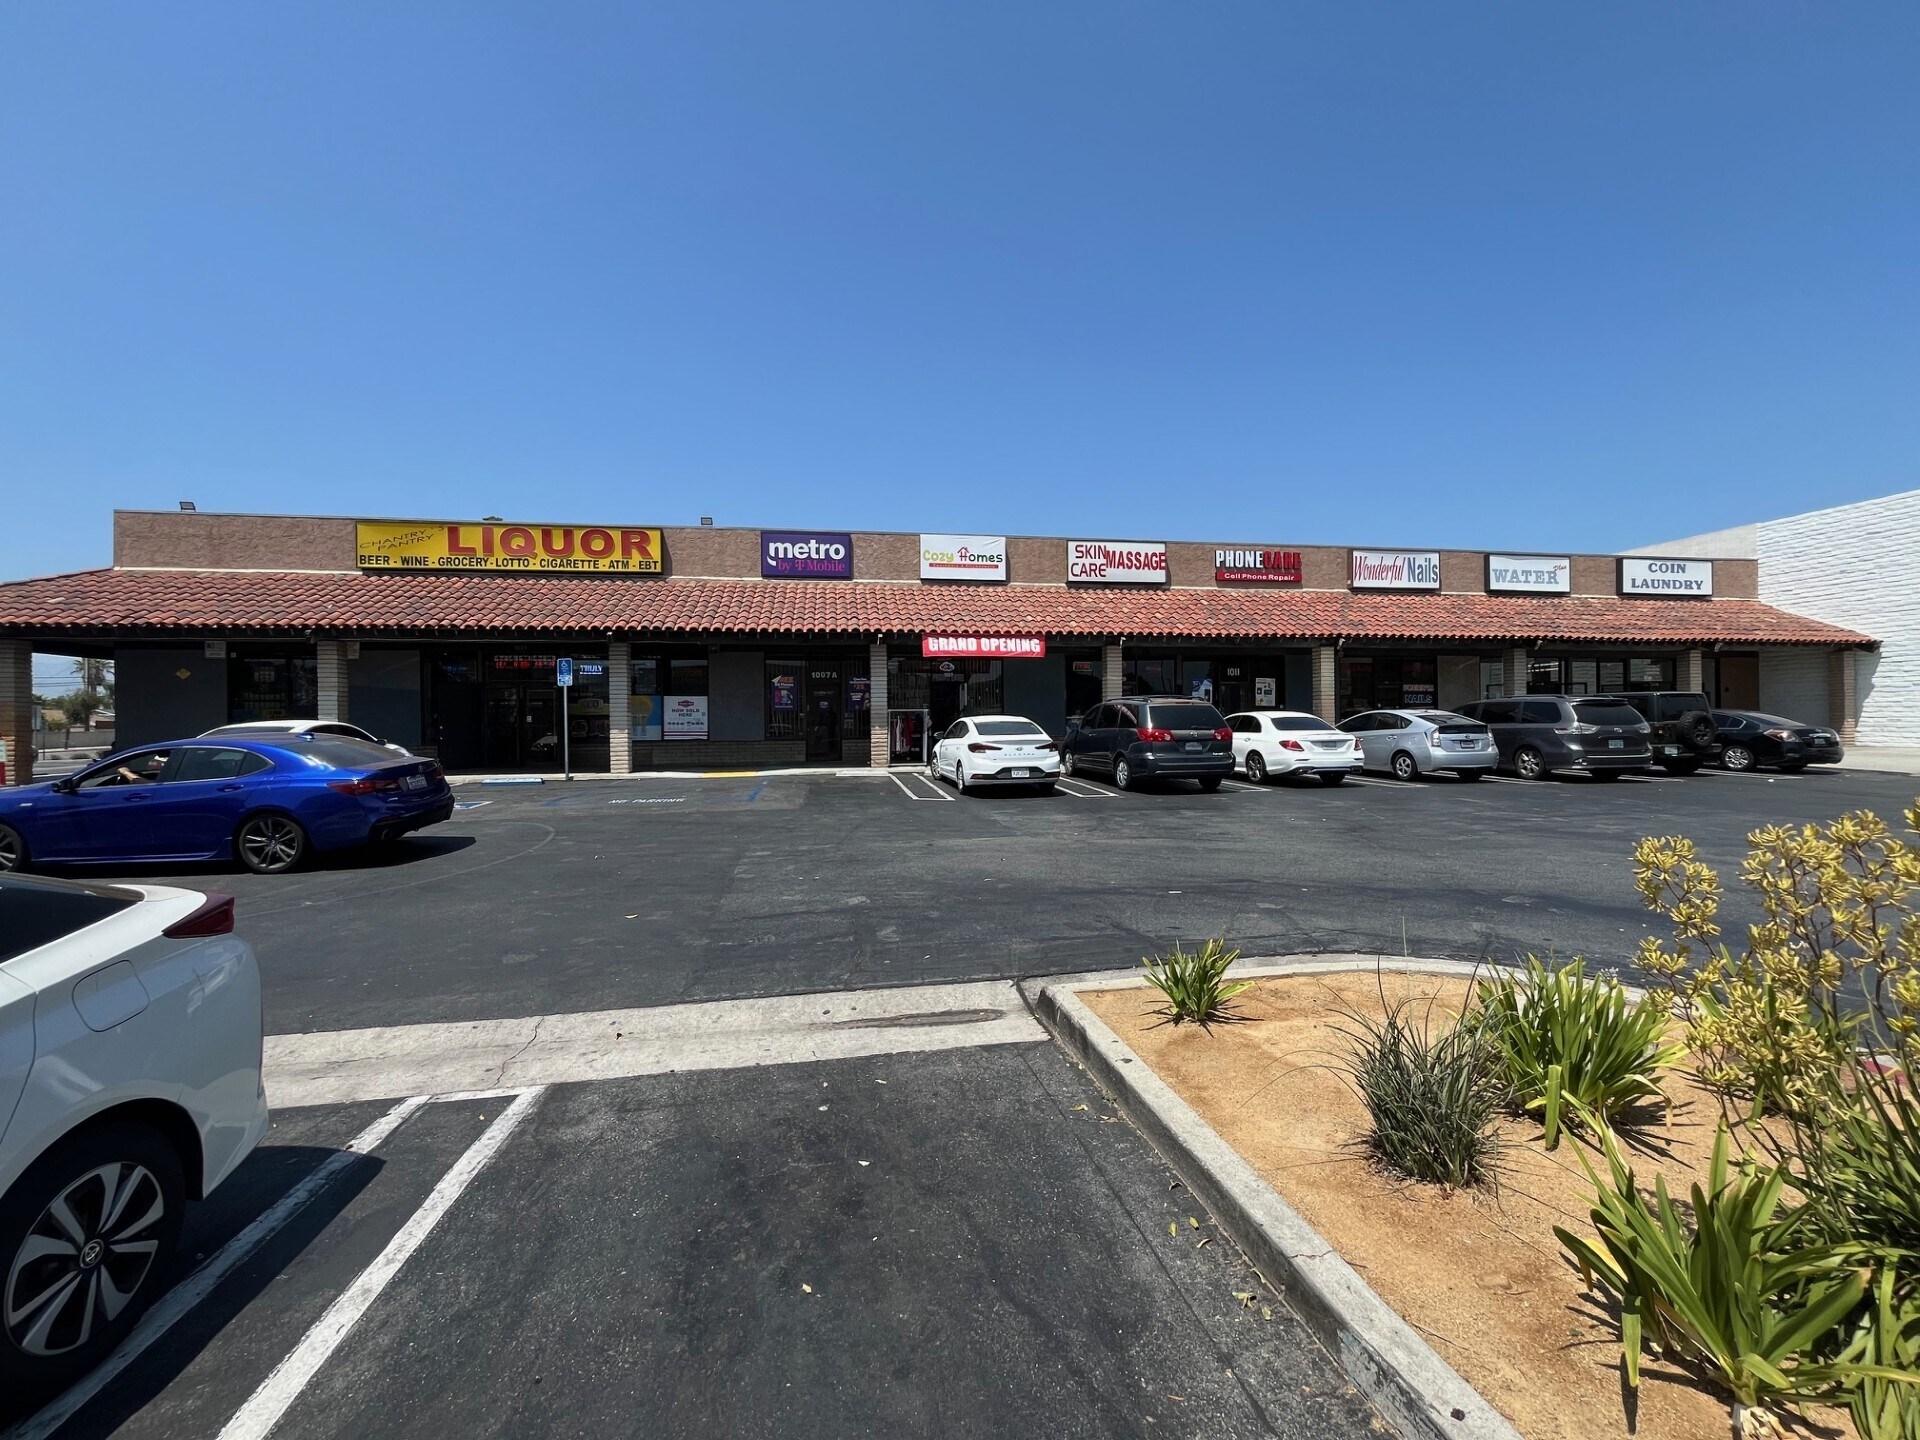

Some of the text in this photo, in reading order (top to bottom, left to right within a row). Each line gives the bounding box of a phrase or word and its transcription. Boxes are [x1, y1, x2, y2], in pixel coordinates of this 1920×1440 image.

[377, 533, 434, 552] PANTRY
[446, 524, 654, 559] LIQUOR
[767, 539, 846, 561] metro
[923, 546, 1003, 563] Cozy Homes
[1074, 544, 1107, 560] SKIN
[1106, 550, 1167, 571] MASSAGE
[359, 554, 391, 566] BEER
[400, 555, 429, 567] WINE
[437, 556, 490, 568] GROCERY
[495, 557, 530, 568] LOTTO
[539, 558, 600, 569] CIGARETTE
[608, 559, 630, 570] ATM
[638, 560, 660, 570] EBT
[778, 560, 792, 573] by
[806, 560, 845, 572] Mobile
[1070, 563, 1107, 577] CARE
[1354, 555, 1439, 585] Wonderful Nails
[1647, 562, 1687, 574] COIN
[1492, 568, 1560, 585] WATER
[1630, 578, 1704, 590] LAUNDRY
[926, 636, 1041, 653] GRAND OPENING
[1404, 694, 1433, 704] NAILS
